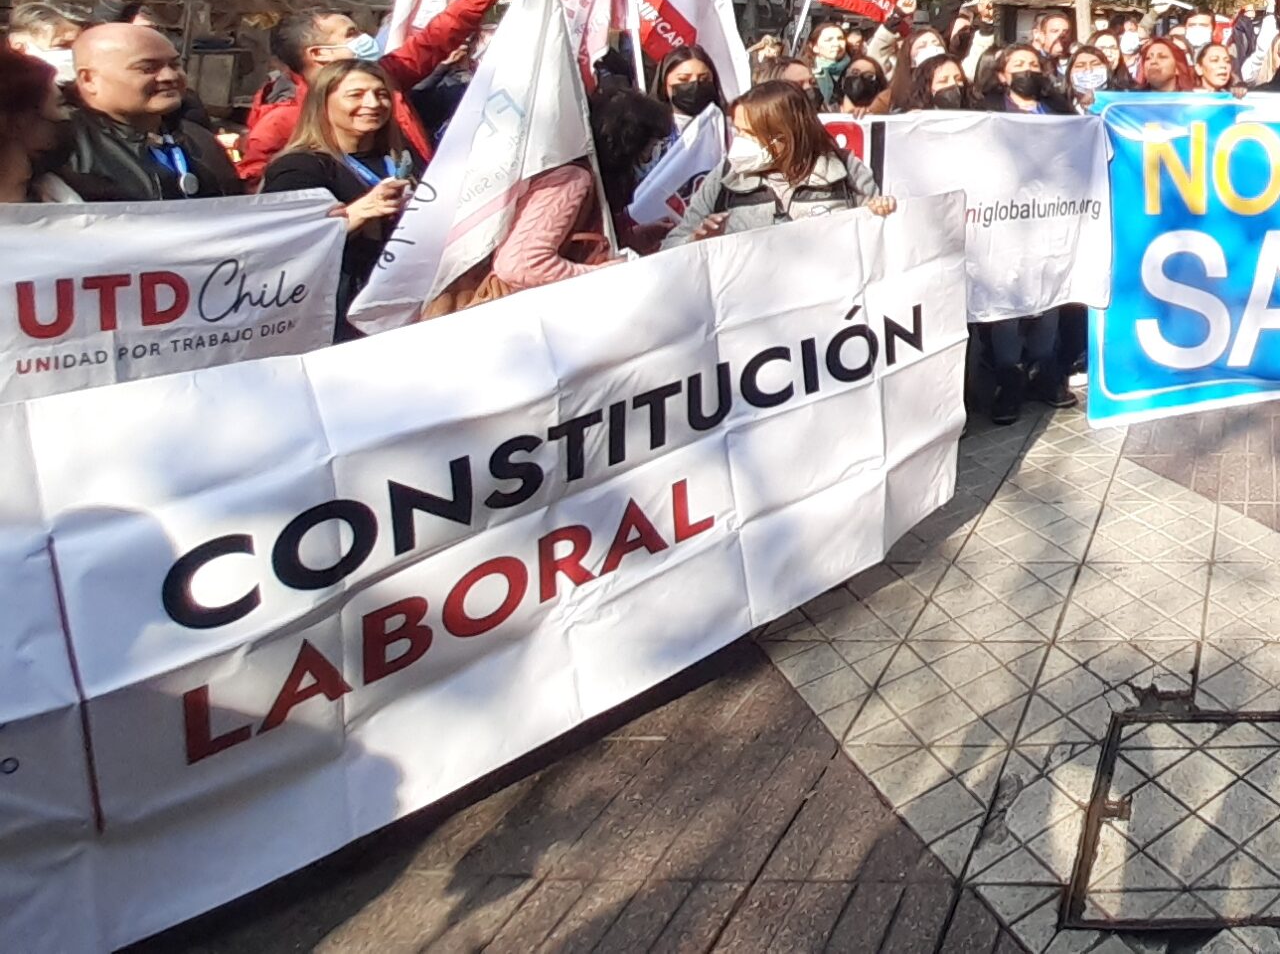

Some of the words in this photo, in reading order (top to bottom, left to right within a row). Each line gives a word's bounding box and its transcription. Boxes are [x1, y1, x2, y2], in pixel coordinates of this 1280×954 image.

[14, 268, 191, 340] UTD
[197, 257, 311, 325] Chile
[16, 347, 109, 375] UNIDAD
[116, 340, 162, 363] POR
[170, 325, 254, 354] TRABAJO
[161, 304, 926, 630] CONSTITUCIÓN
[181, 478, 717, 766] LABORAL
